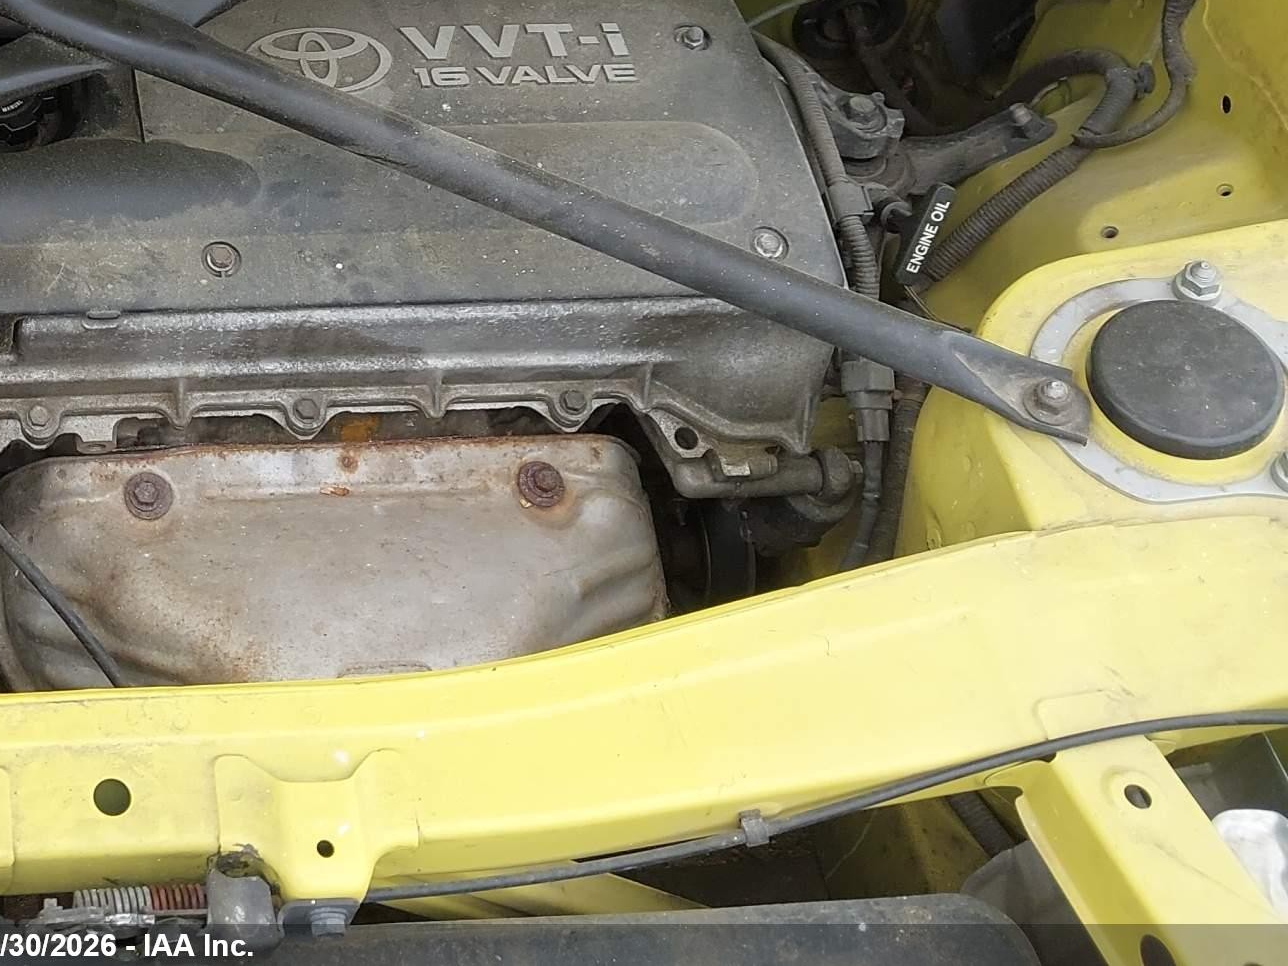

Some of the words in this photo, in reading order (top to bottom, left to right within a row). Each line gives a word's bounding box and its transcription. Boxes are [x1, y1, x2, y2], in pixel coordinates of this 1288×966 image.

[400, 23, 631, 60] VVT-i
[414, 66, 468, 87] 16
[475, 64, 638, 85] VALVE
[906, 223, 939, 273] ENGINE
[930, 201, 951, 222] OIL
